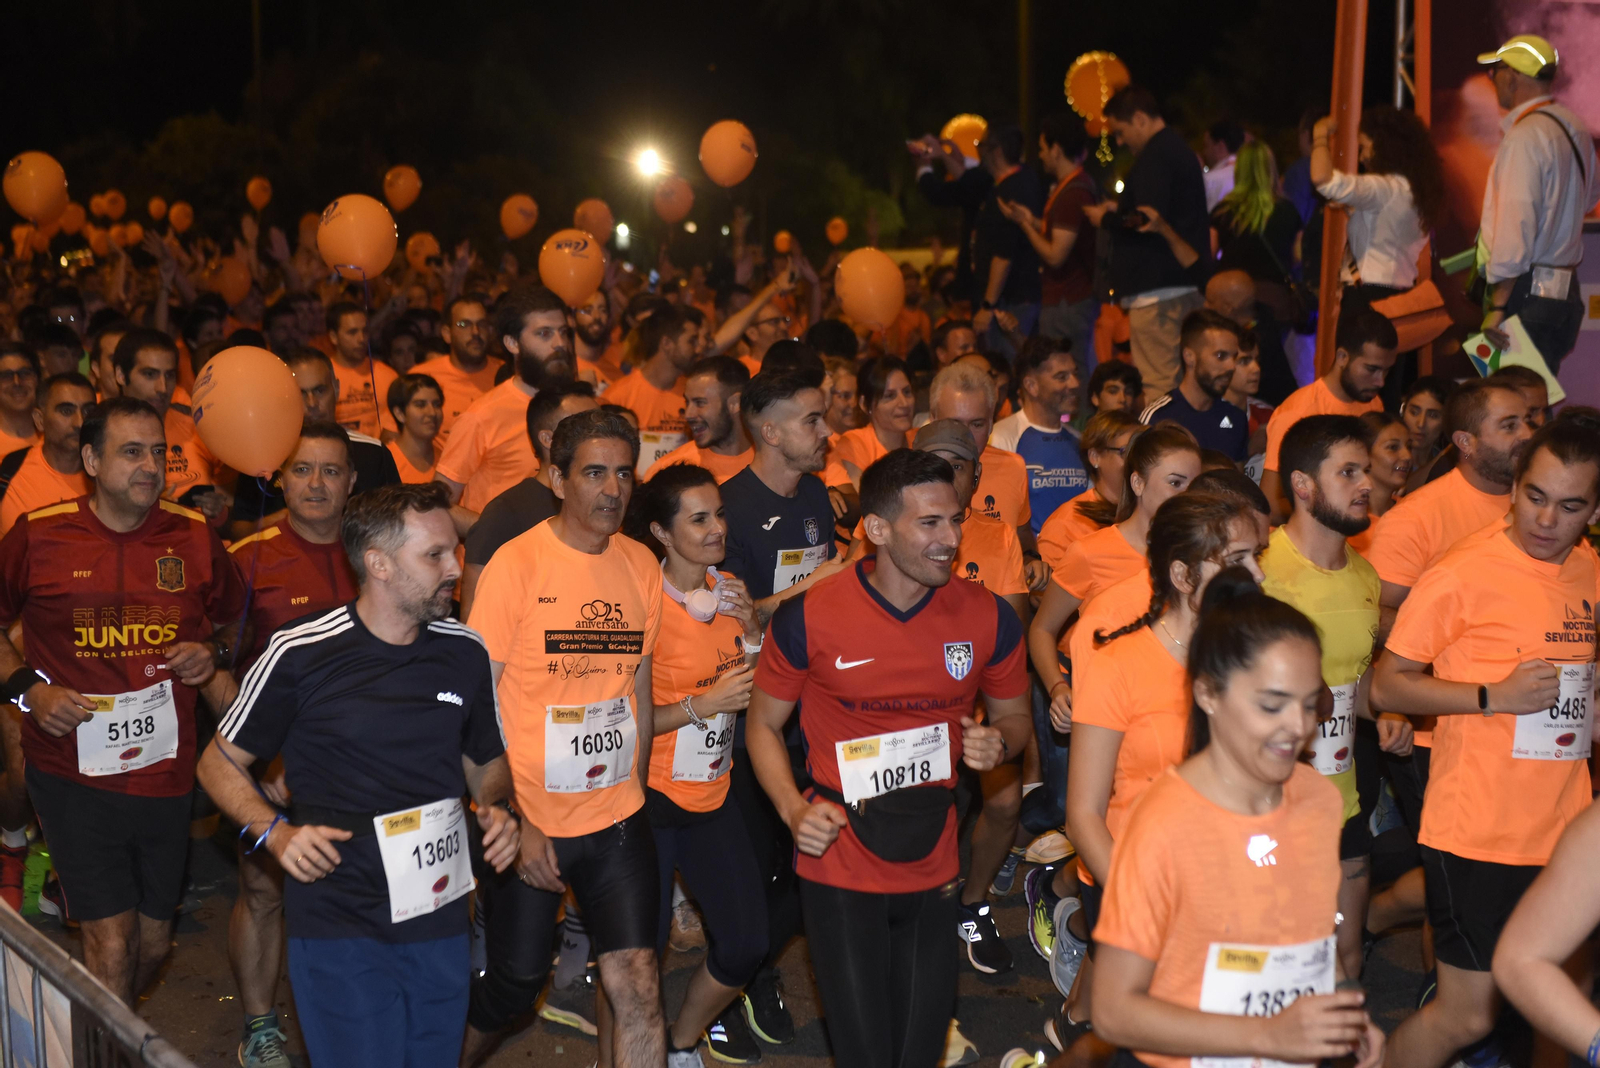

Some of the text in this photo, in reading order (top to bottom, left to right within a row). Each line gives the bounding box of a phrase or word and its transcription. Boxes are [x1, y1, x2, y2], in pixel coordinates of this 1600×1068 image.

[603, 602, 623, 622] 25
[575, 619, 629, 630] aniversario
[73, 624, 179, 648] JUNTOS
[546, 633, 573, 641] CARRERA
[574, 634, 600, 642] NOCTURNA
[559, 642, 580, 650] Gran
[581, 643, 604, 651] Premio
[1545, 633, 1583, 643] SEVILLA
[715, 656, 745, 674] NOCTURN
[861, 701, 902, 712] ROAD
[1550, 697, 1586, 719] 6485
[108, 715, 155, 741] 5138
[705, 724, 733, 748] 6405
[571, 729, 623, 756] 16030
[870, 760, 931, 793] 10818
[412, 830, 460, 870] 13603
